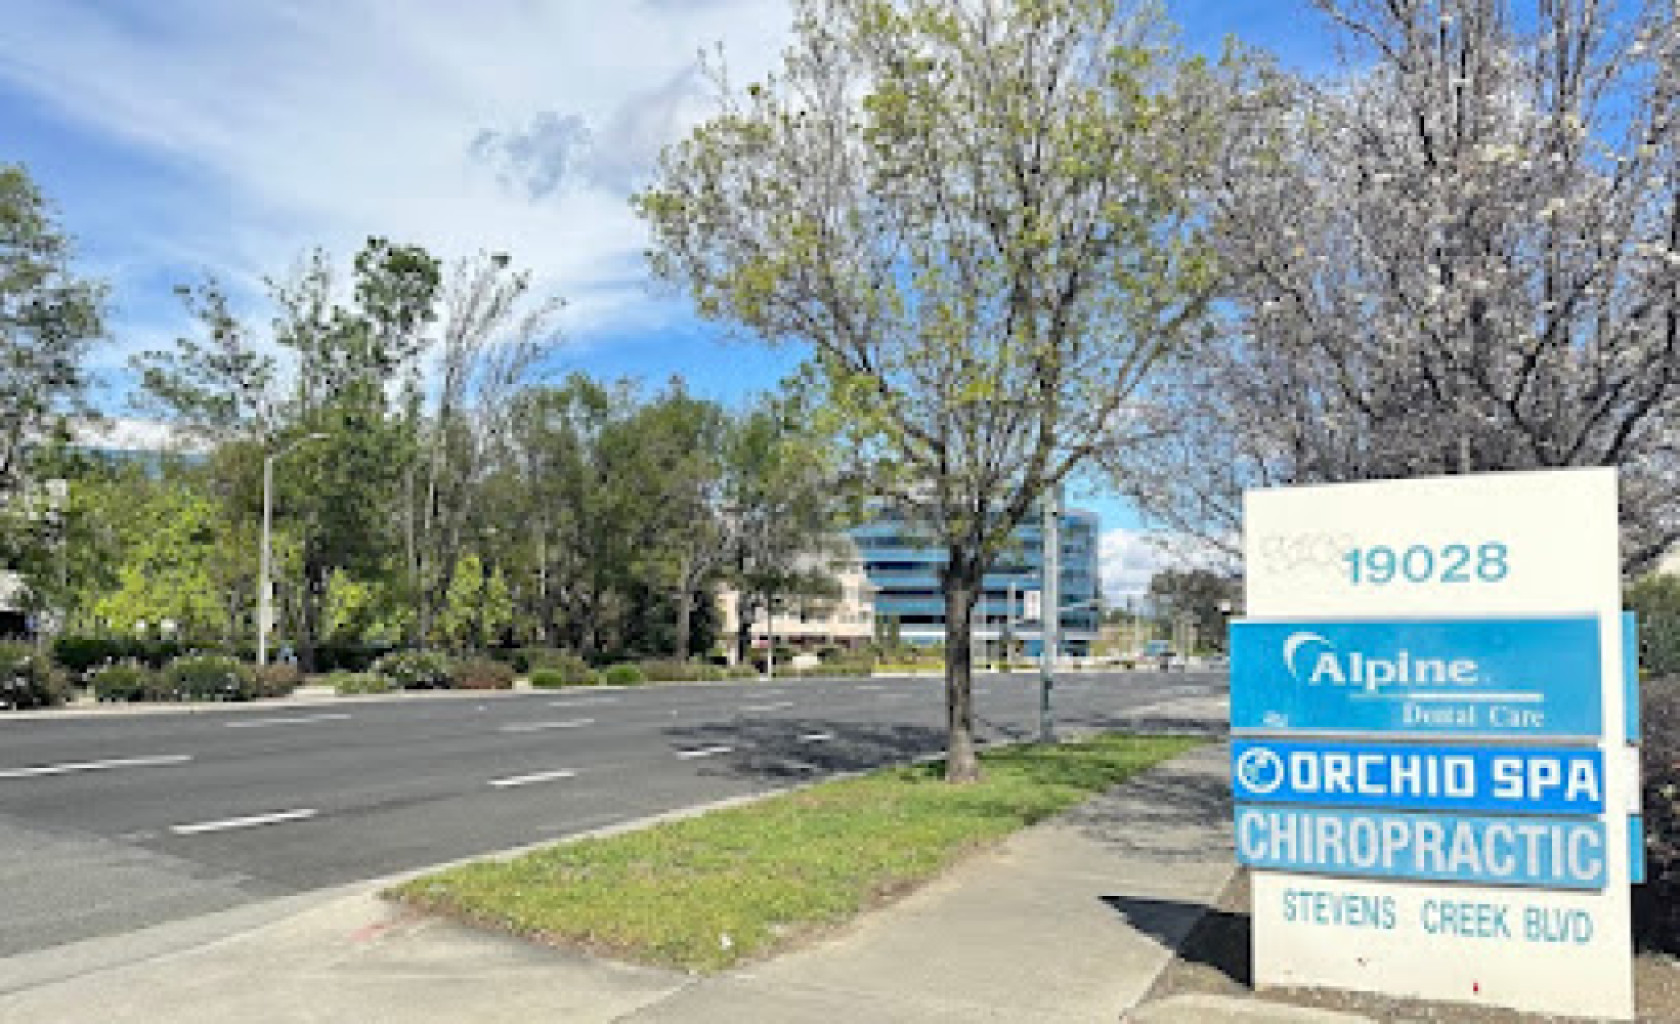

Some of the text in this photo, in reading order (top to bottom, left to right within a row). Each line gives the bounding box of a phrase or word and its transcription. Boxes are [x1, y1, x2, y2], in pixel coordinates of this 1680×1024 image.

[1343, 542, 1509, 584] 19028
[1309, 650, 1480, 690] Alpine
[1402, 702, 1545, 728] Dental Care
[1289, 751, 1600, 802] ORCHID SPA
[1238, 812, 1602, 879] CHIROPRACTIC
[1282, 890, 1594, 944] STEVENS CREEK BLVD
